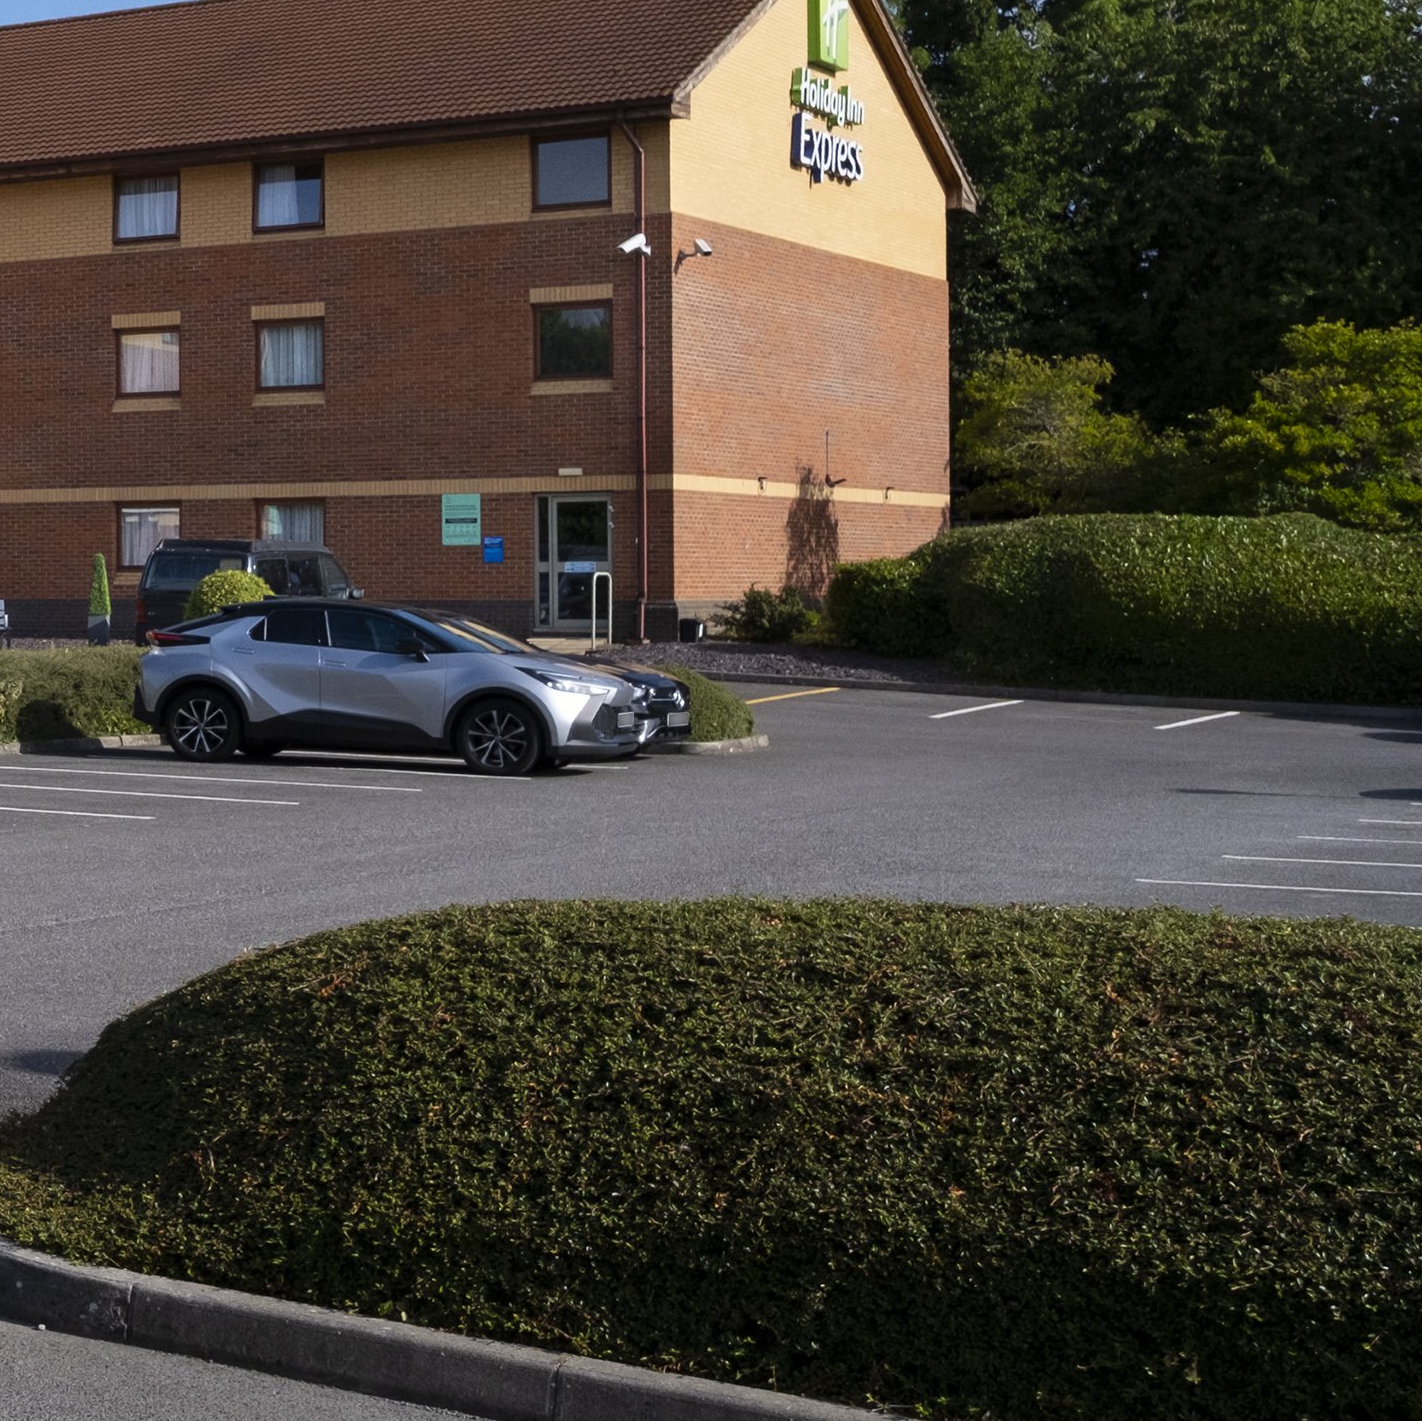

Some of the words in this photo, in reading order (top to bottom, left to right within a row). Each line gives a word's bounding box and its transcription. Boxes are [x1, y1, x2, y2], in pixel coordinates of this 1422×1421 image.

[800, 67, 846, 127] Holiday
[847, 85, 865, 124] Inn
[800, 113, 865, 182] Express
